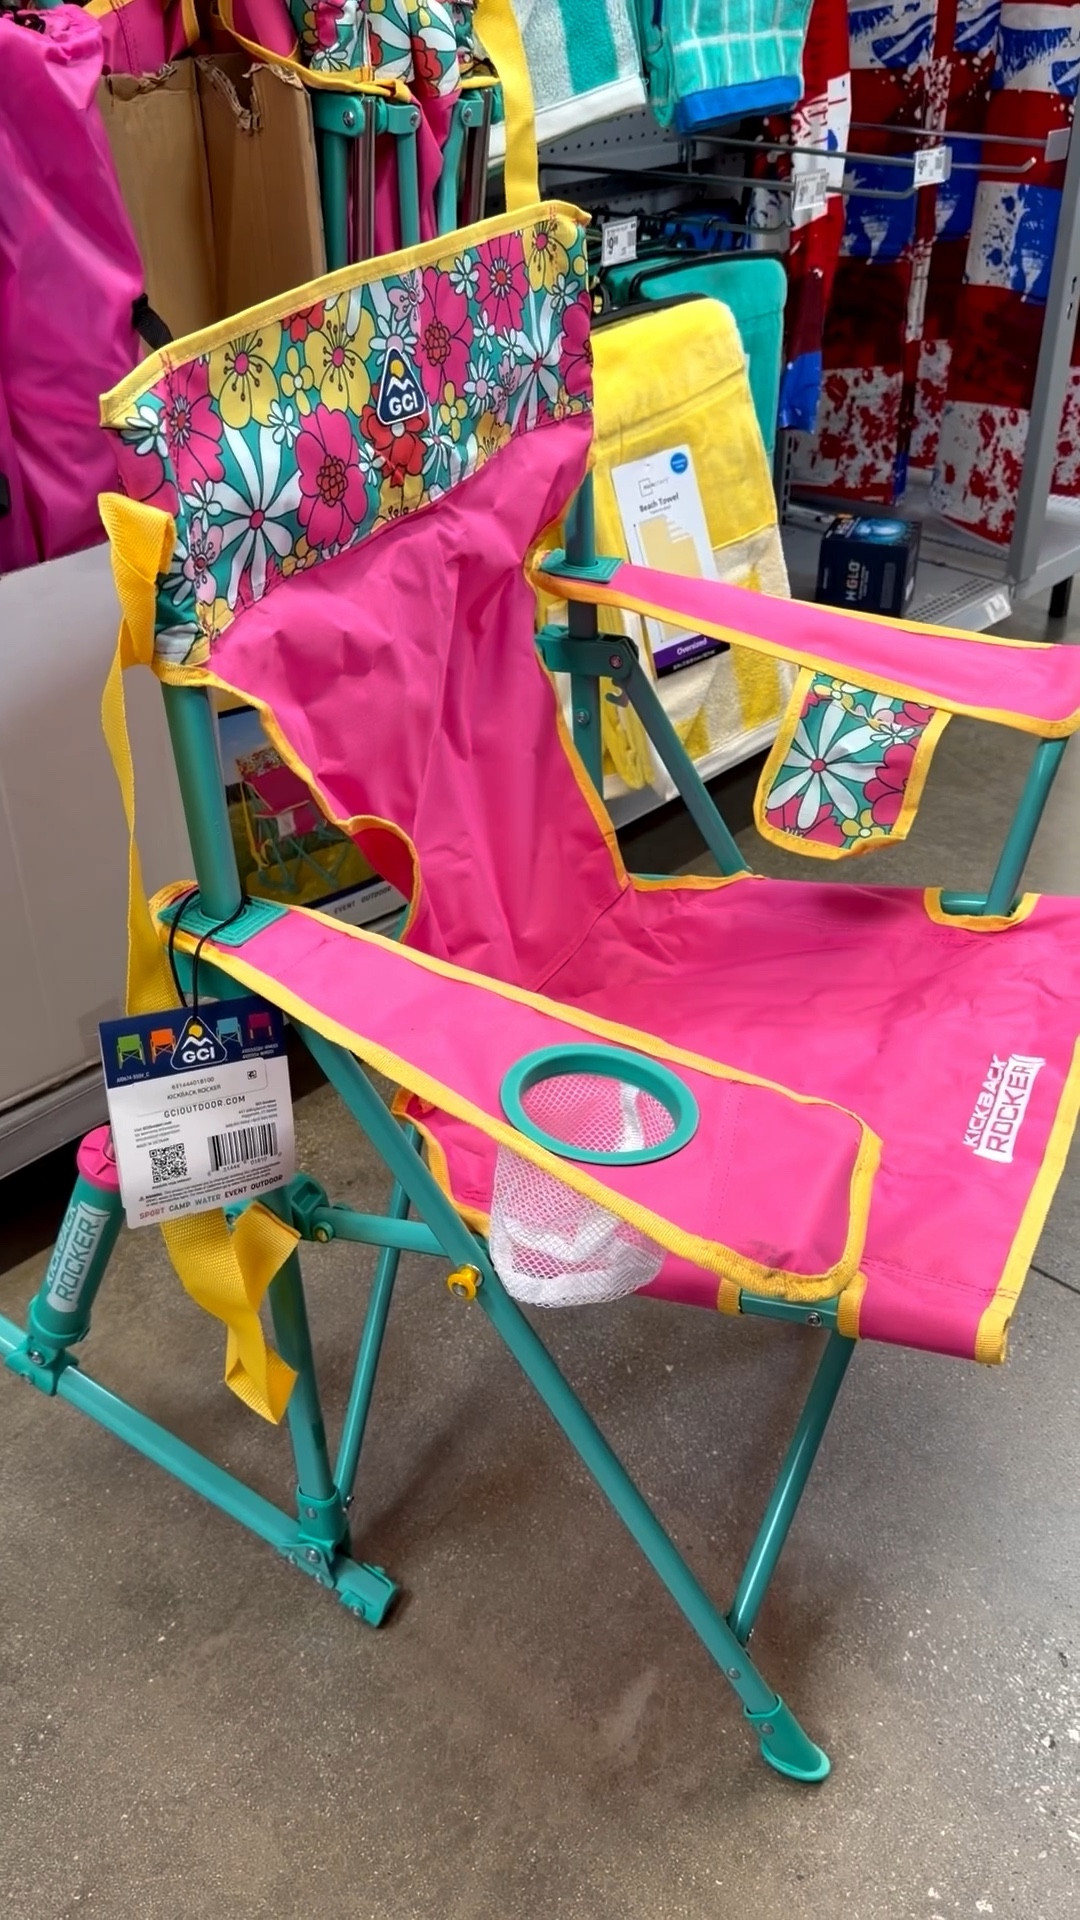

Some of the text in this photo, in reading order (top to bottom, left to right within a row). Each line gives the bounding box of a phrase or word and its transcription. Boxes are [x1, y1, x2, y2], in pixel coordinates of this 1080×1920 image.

[389, 391, 419, 416] GCI
[639, 500, 658, 513] Beach
[658, 491, 679, 504] Towel
[677, 637, 708, 656] Oversized
[334, 886, 391, 914] EVENT OUTDOOR
[182, 1046, 215, 1064] GCI
[167, 1084, 222, 1100] KICKBACK ROCKER
[962, 1053, 1008, 1150] KICKBACK
[164, 1095, 246, 1118] GCIOUTDOOR.COM
[986, 1065, 1034, 1154] ROCKER
[139, 1207, 165, 1220] SPORT
[168, 1201, 191, 1212] CAMP
[195, 1194, 221, 1206] WATER
[224, 1187, 248, 1199] EVENT
[250, 1174, 283, 1191] OUTDOOR
[55, 1217, 99, 1302] ROCKER
